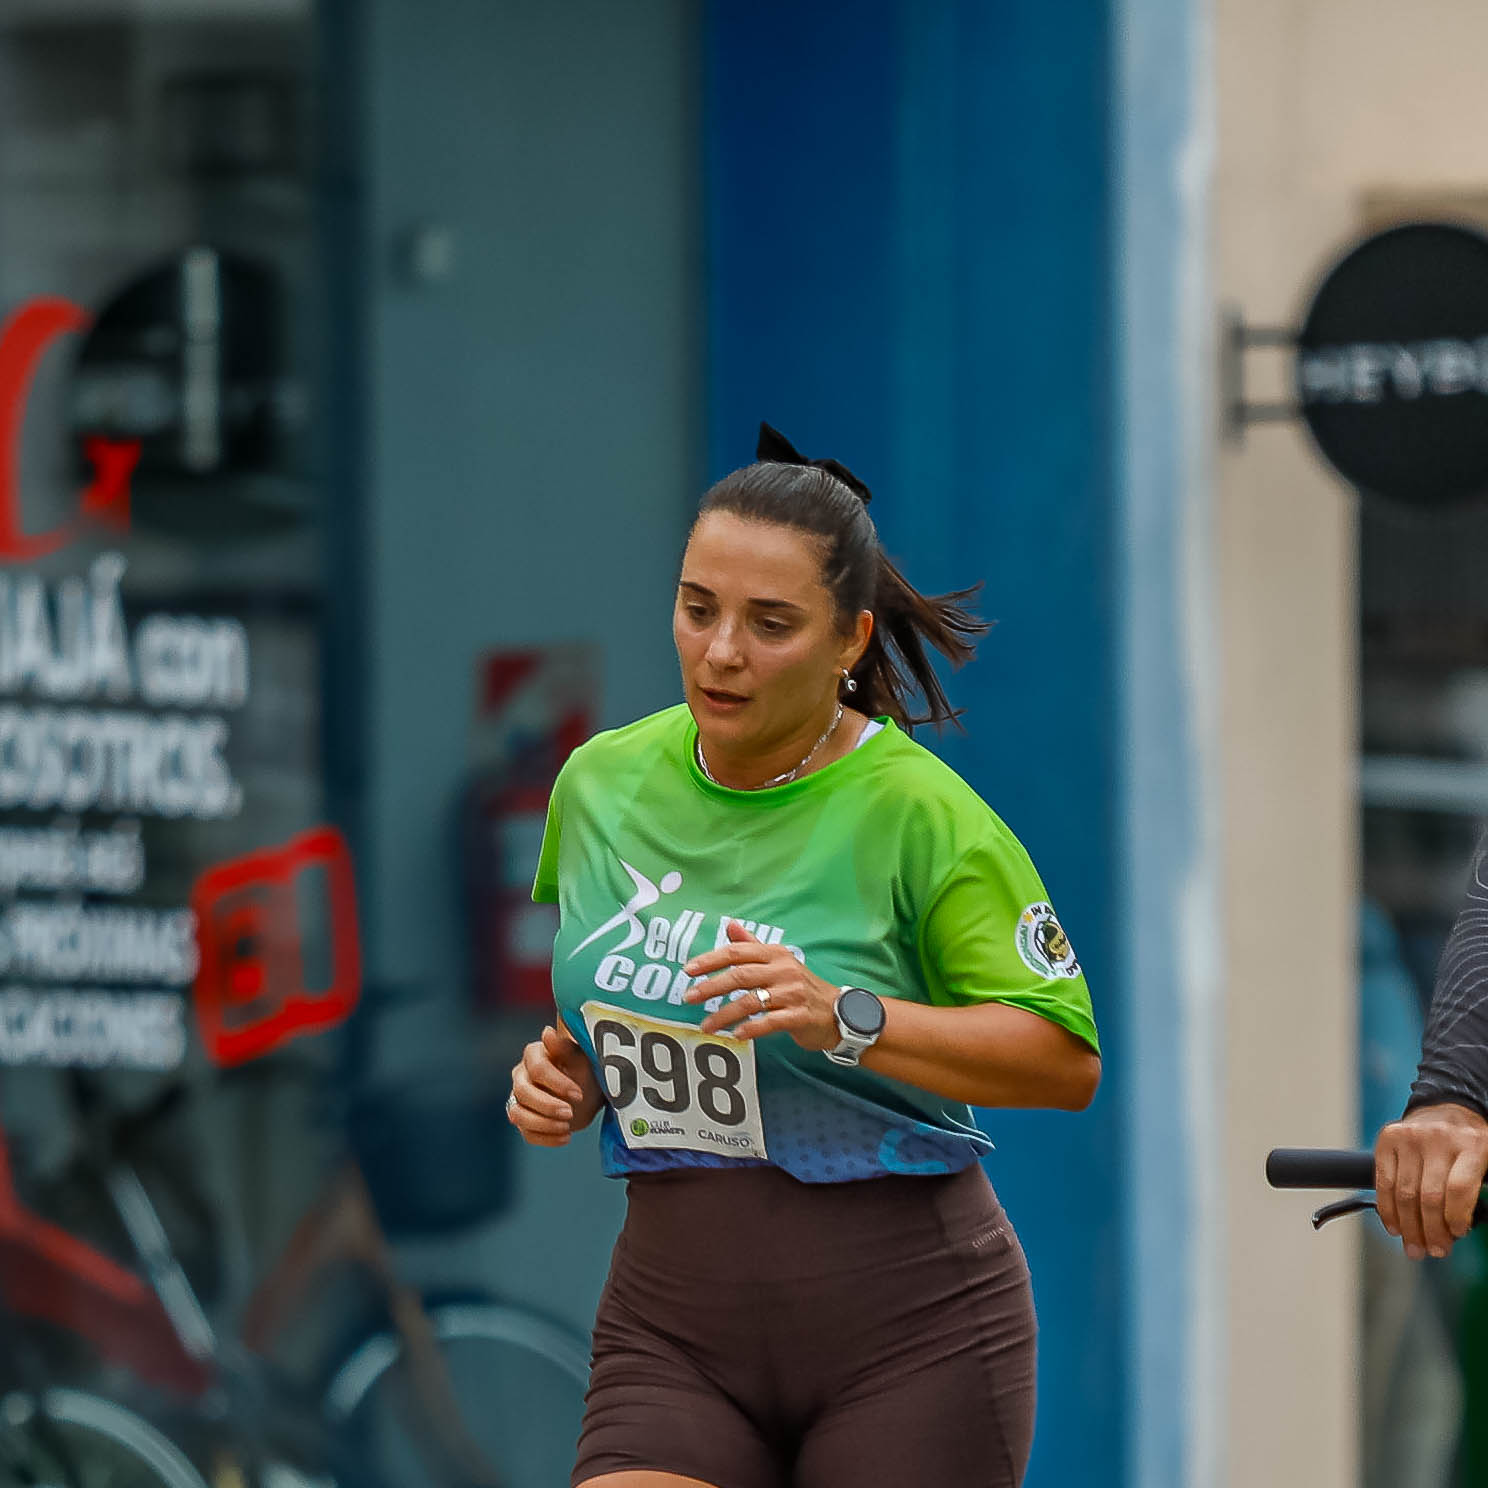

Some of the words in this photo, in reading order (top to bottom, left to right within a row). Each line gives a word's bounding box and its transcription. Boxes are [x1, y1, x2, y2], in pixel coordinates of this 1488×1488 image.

[138, 614, 250, 708] con
[594, 1020, 746, 1127] 698
[698, 1129, 751, 1148] CARUSO
